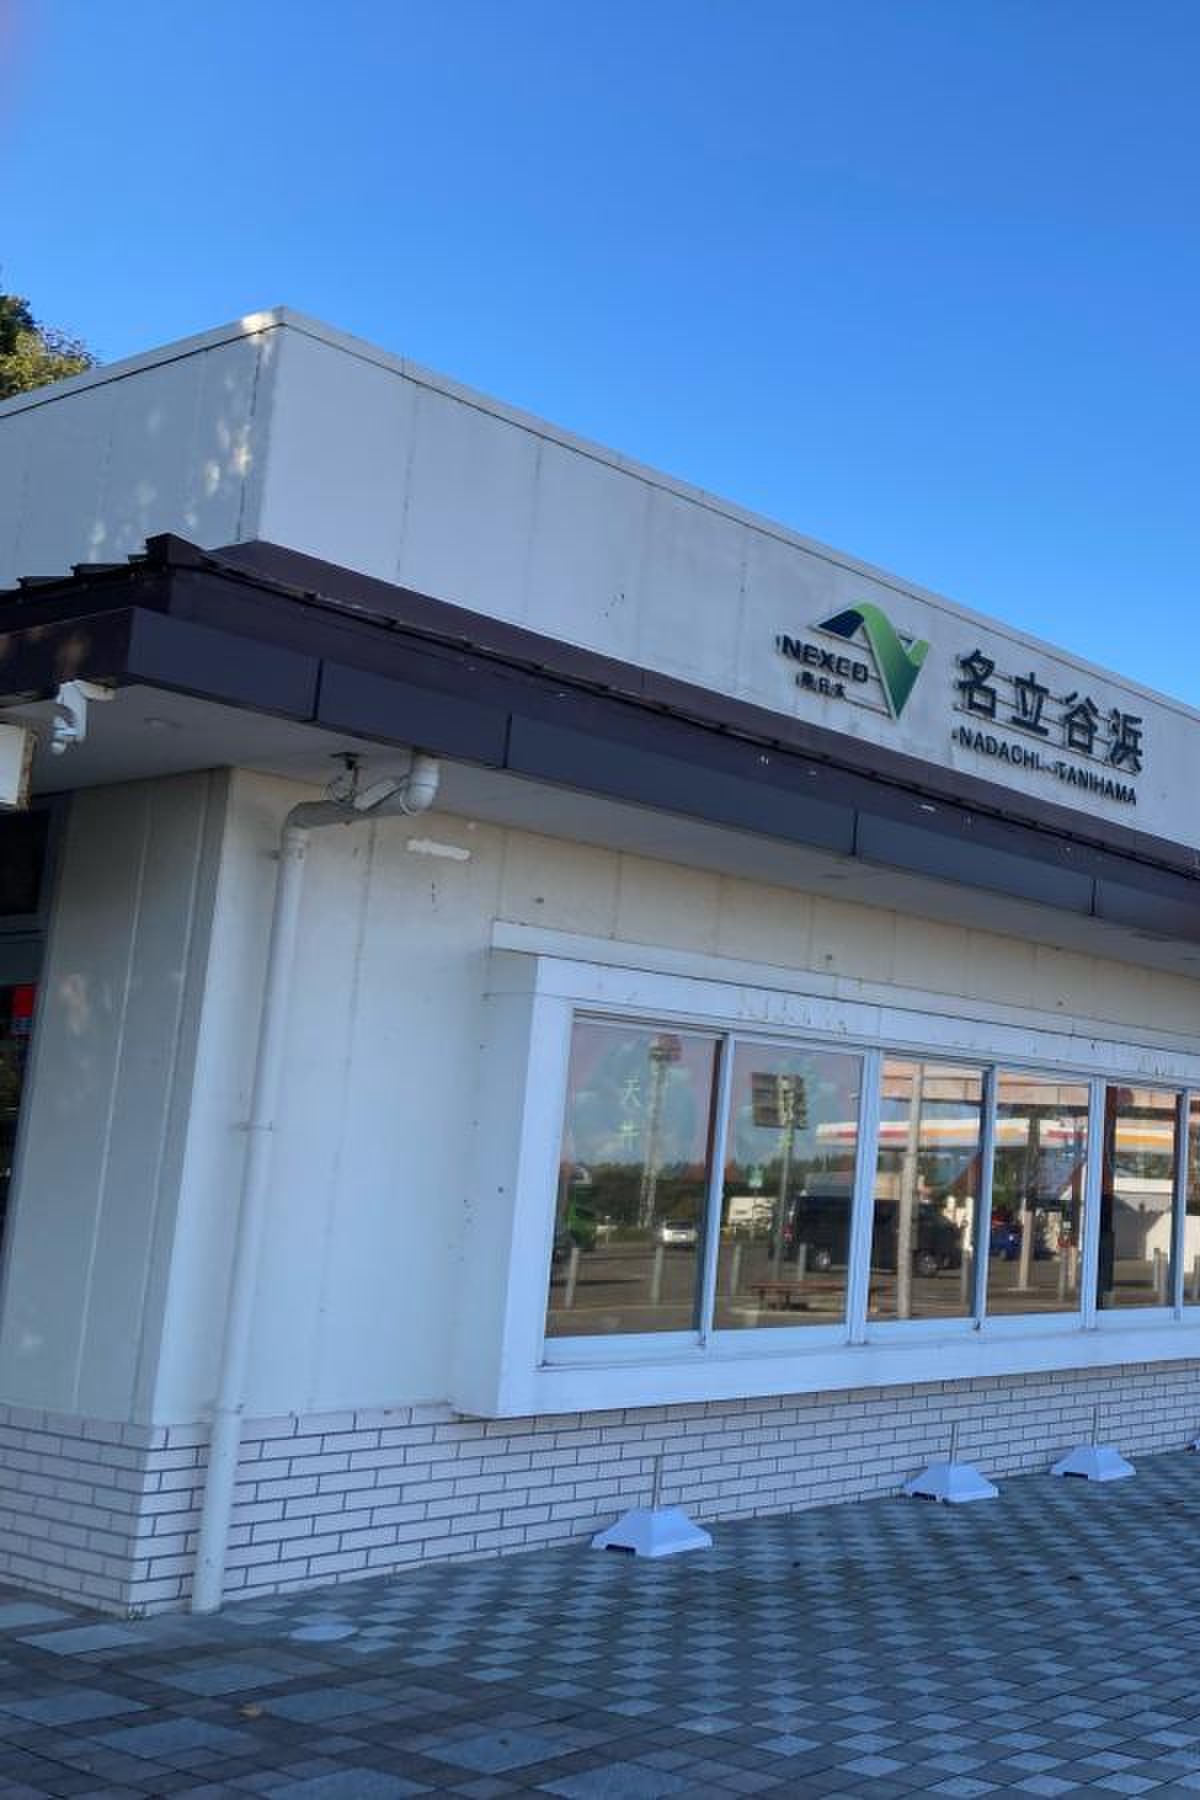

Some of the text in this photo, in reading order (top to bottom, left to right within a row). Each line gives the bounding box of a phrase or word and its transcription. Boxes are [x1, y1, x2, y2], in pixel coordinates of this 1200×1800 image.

[782, 634, 869, 684] NEXCO
[956, 648, 1143, 772] 名立谷浜
[958, 724, 1137, 806] NADACHI TANIHAMA
